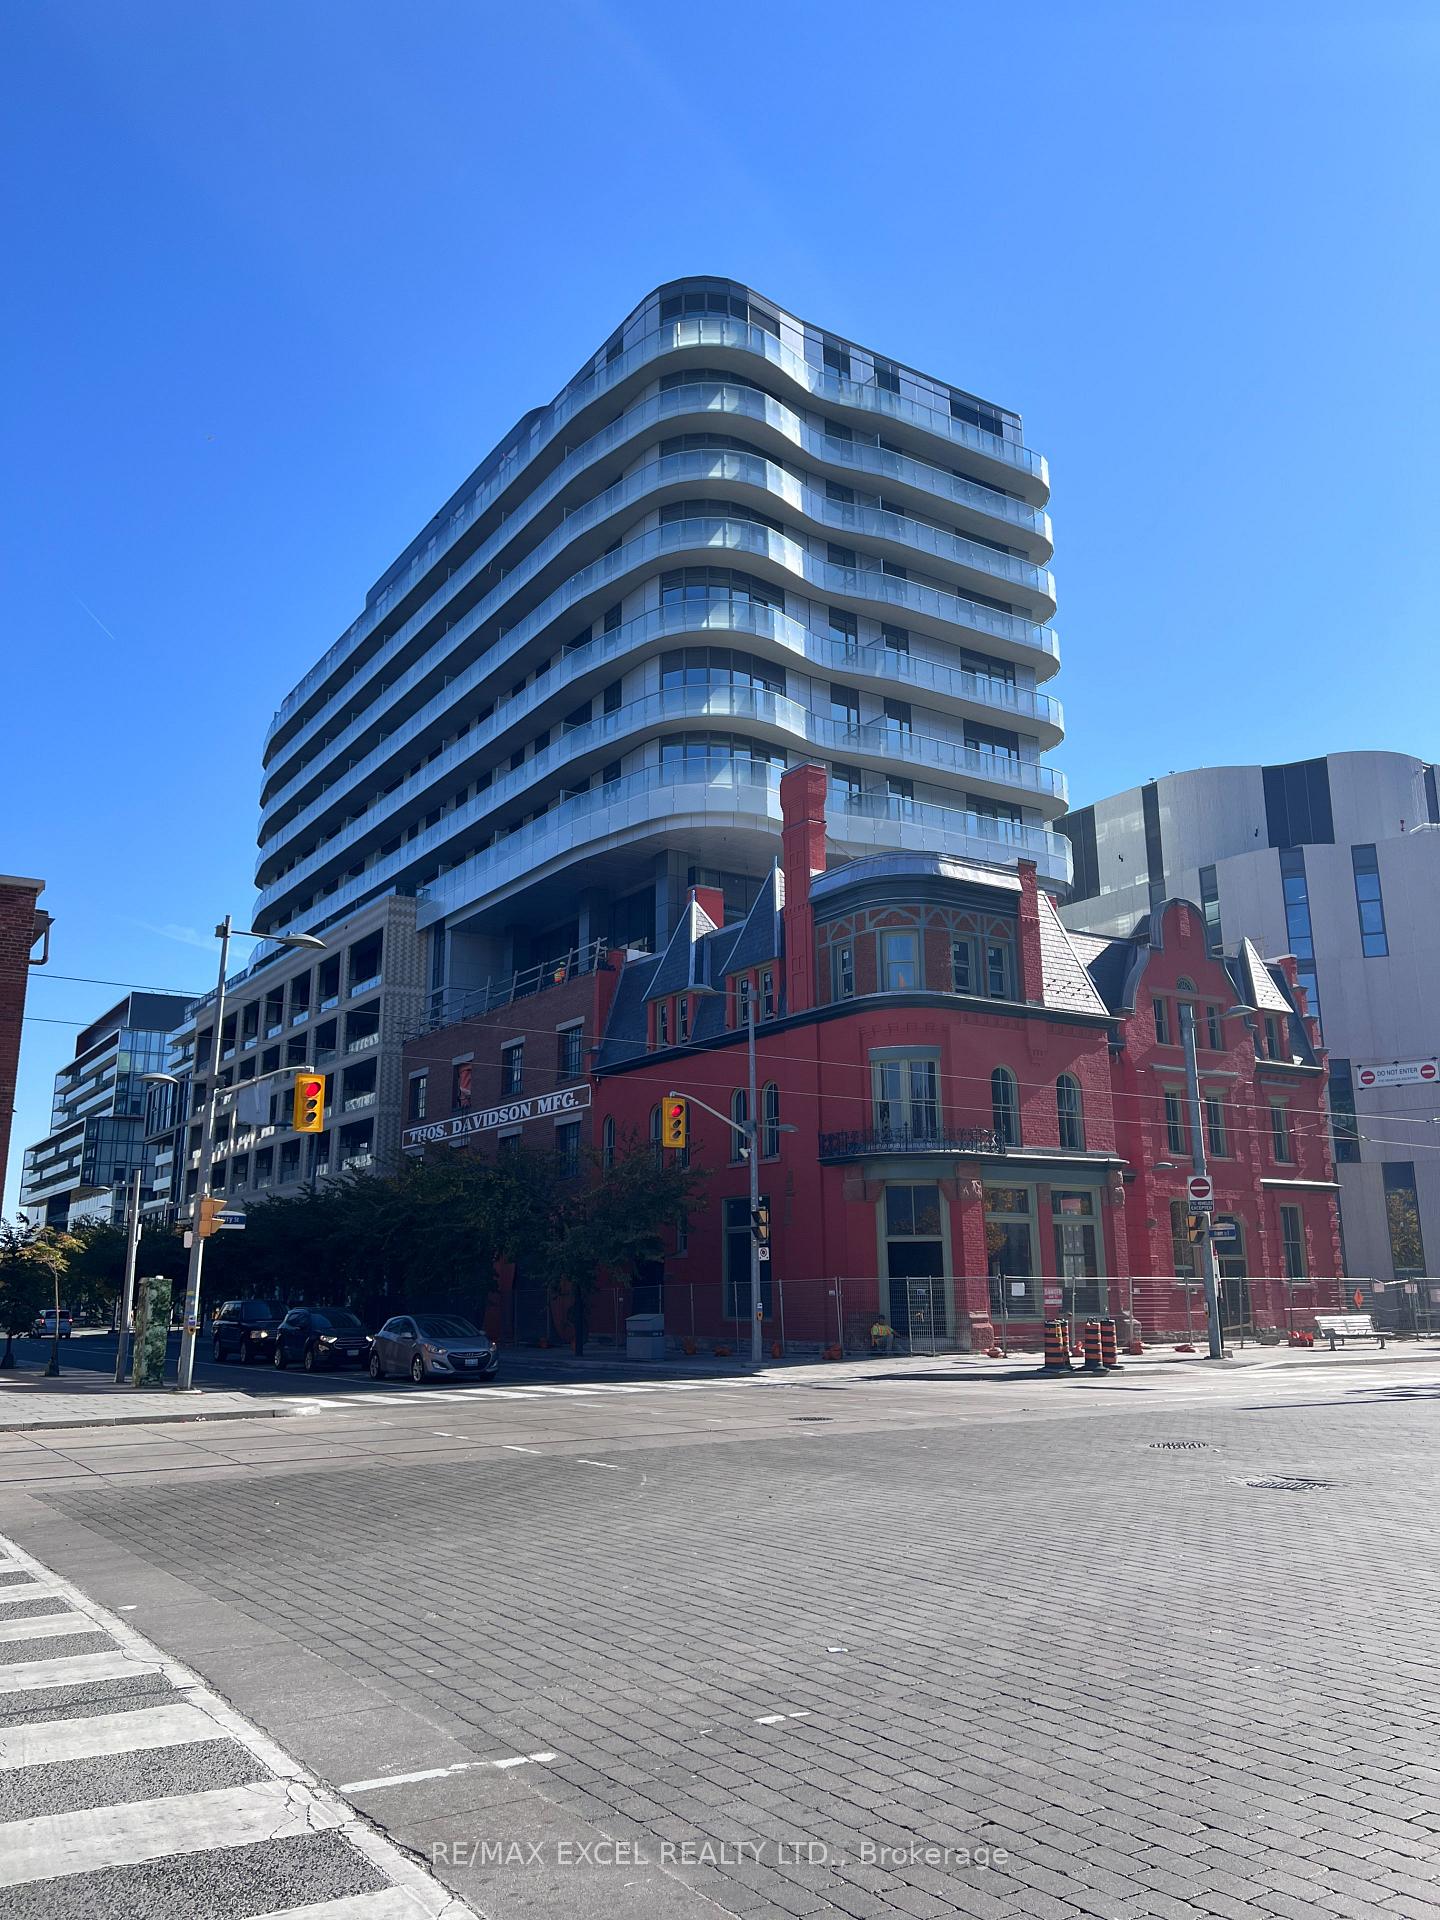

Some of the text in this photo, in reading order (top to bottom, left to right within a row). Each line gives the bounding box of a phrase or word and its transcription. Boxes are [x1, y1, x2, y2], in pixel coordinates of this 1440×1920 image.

[409, 1092, 579, 1143] THOS. DAVIDSON MFG.
